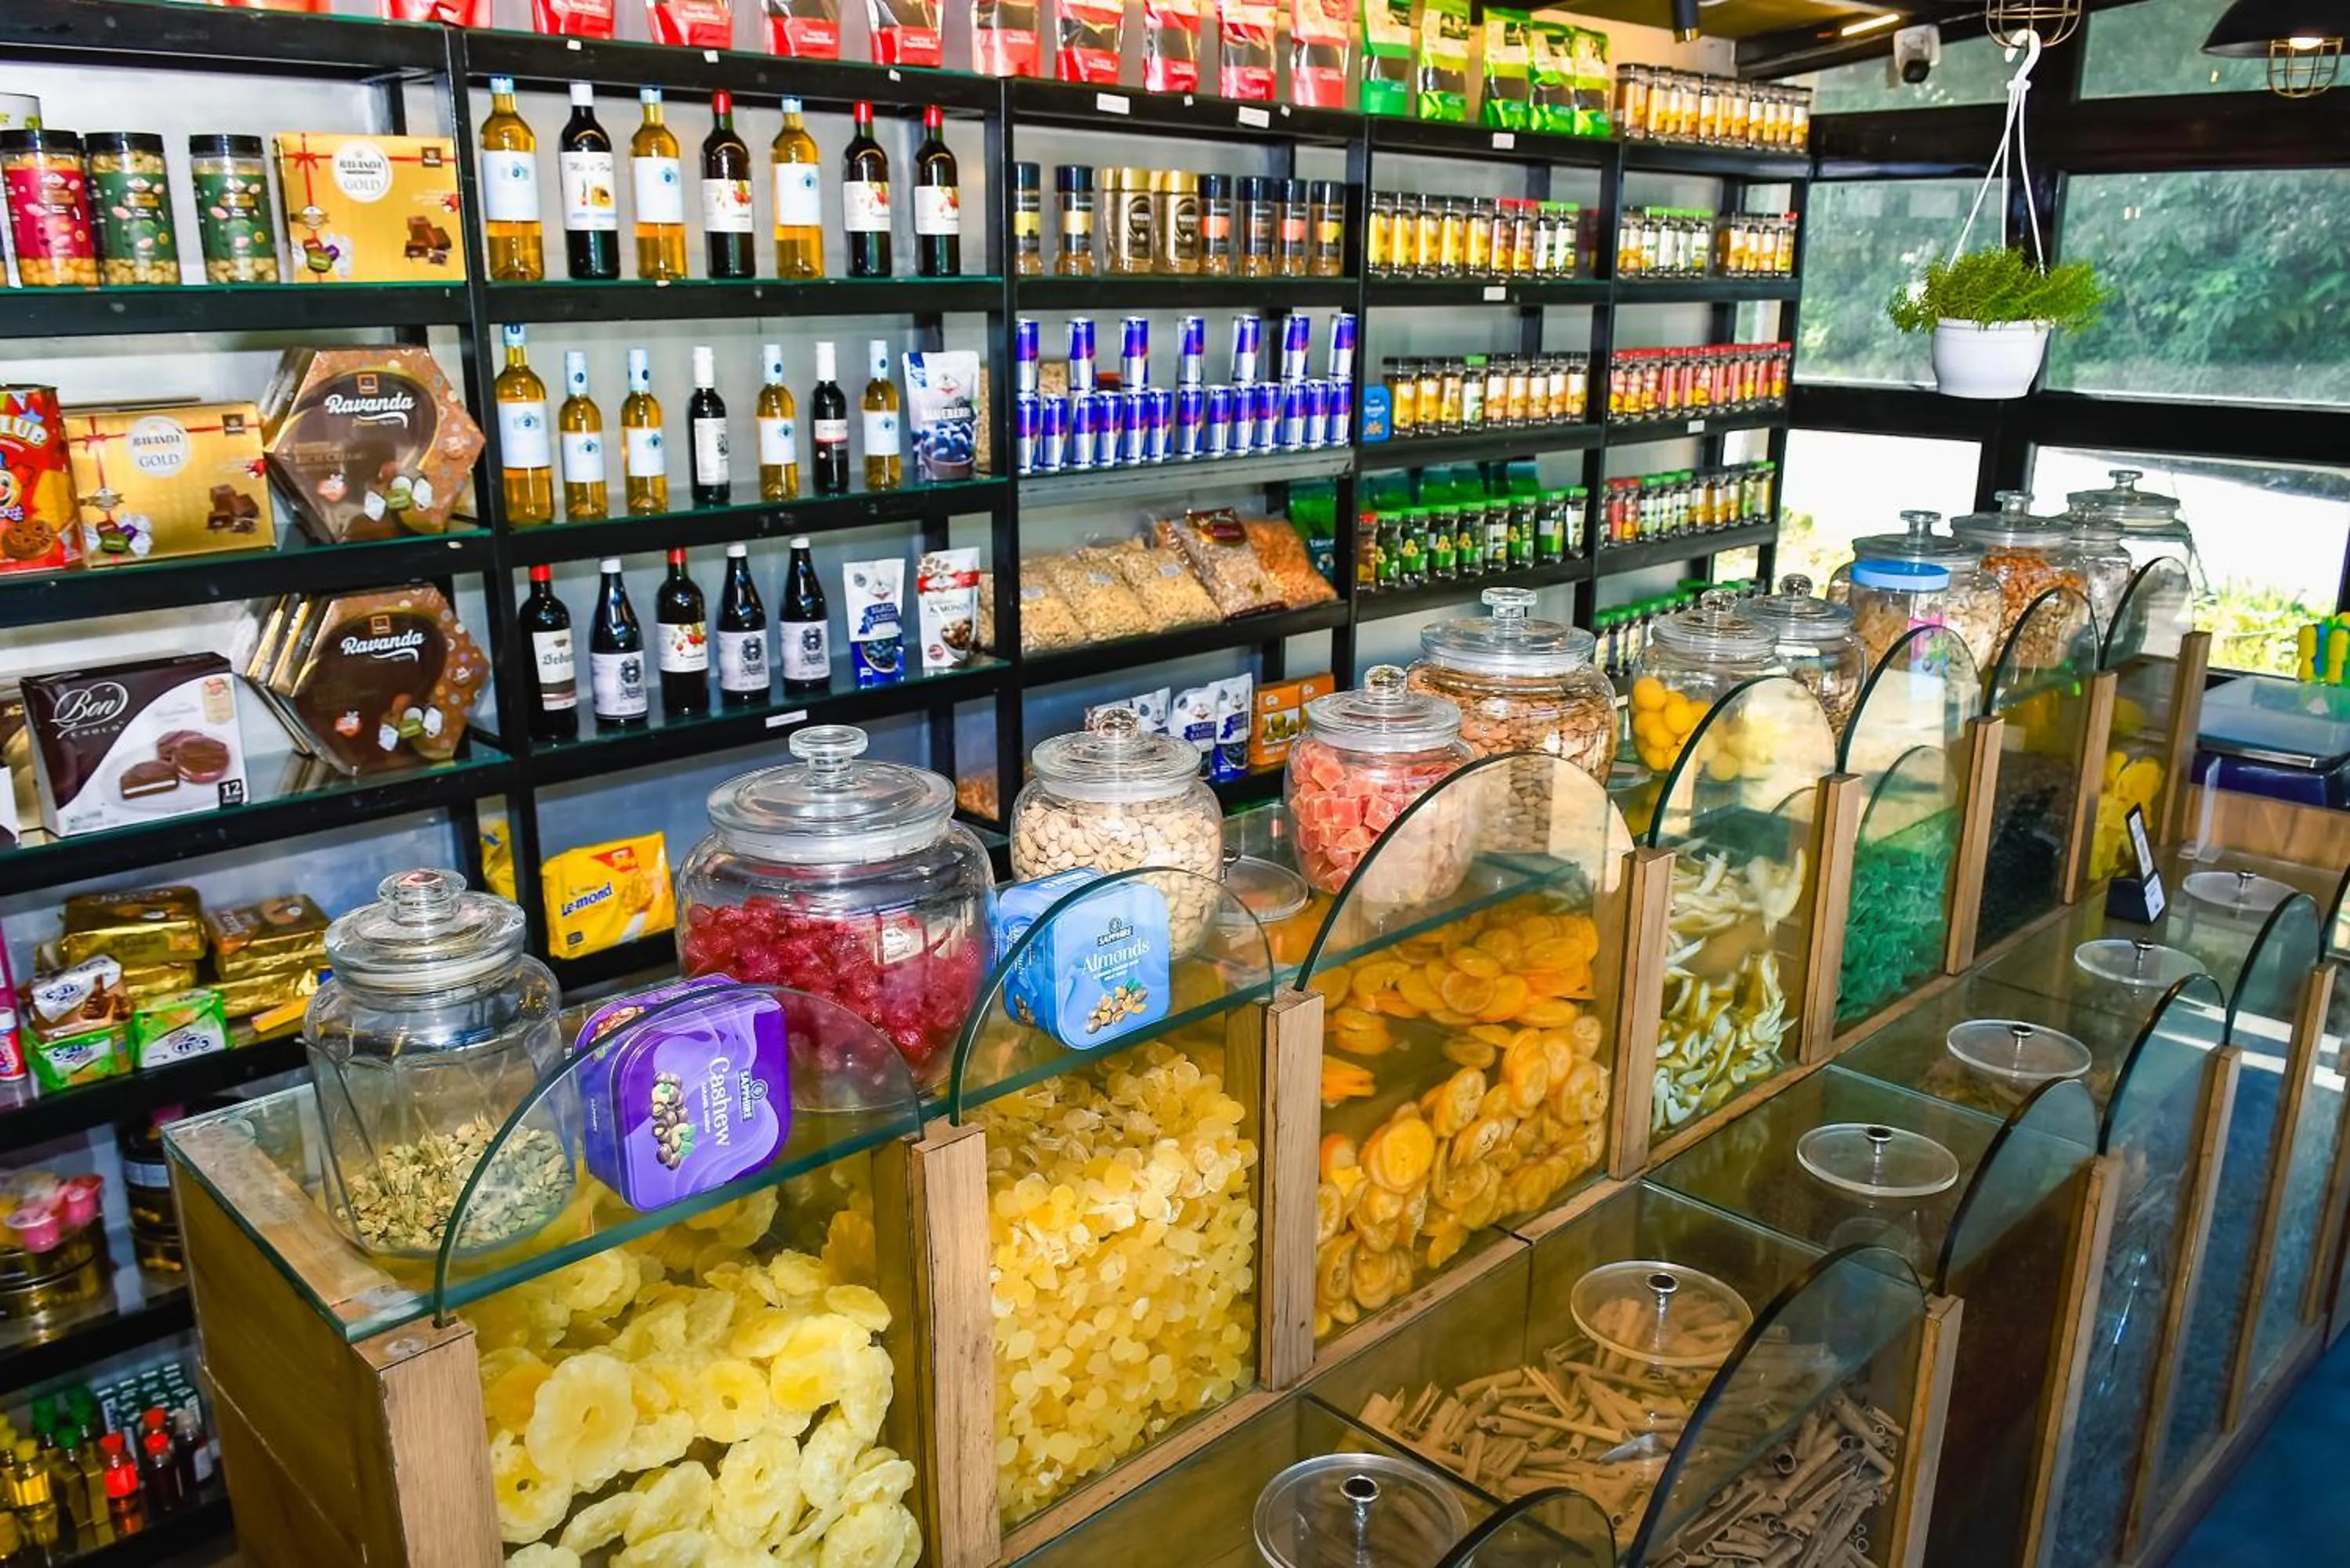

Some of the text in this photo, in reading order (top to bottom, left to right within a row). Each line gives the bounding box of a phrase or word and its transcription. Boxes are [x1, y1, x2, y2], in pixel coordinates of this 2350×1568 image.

[343, 178, 381, 191] GOLD
[324, 392, 415, 414] Ravanda
[138, 453, 180, 469] GOLD
[340, 629, 426, 656] Ravanda
[50, 681, 128, 729] Bon
[221, 781, 241, 797] 12
[561, 880, 613, 917] Le-mond
[1080, 938, 1151, 976] Almonds
[709, 1057, 731, 1146] Cashew
[739, 1070, 752, 1120] SAPPHIRE
